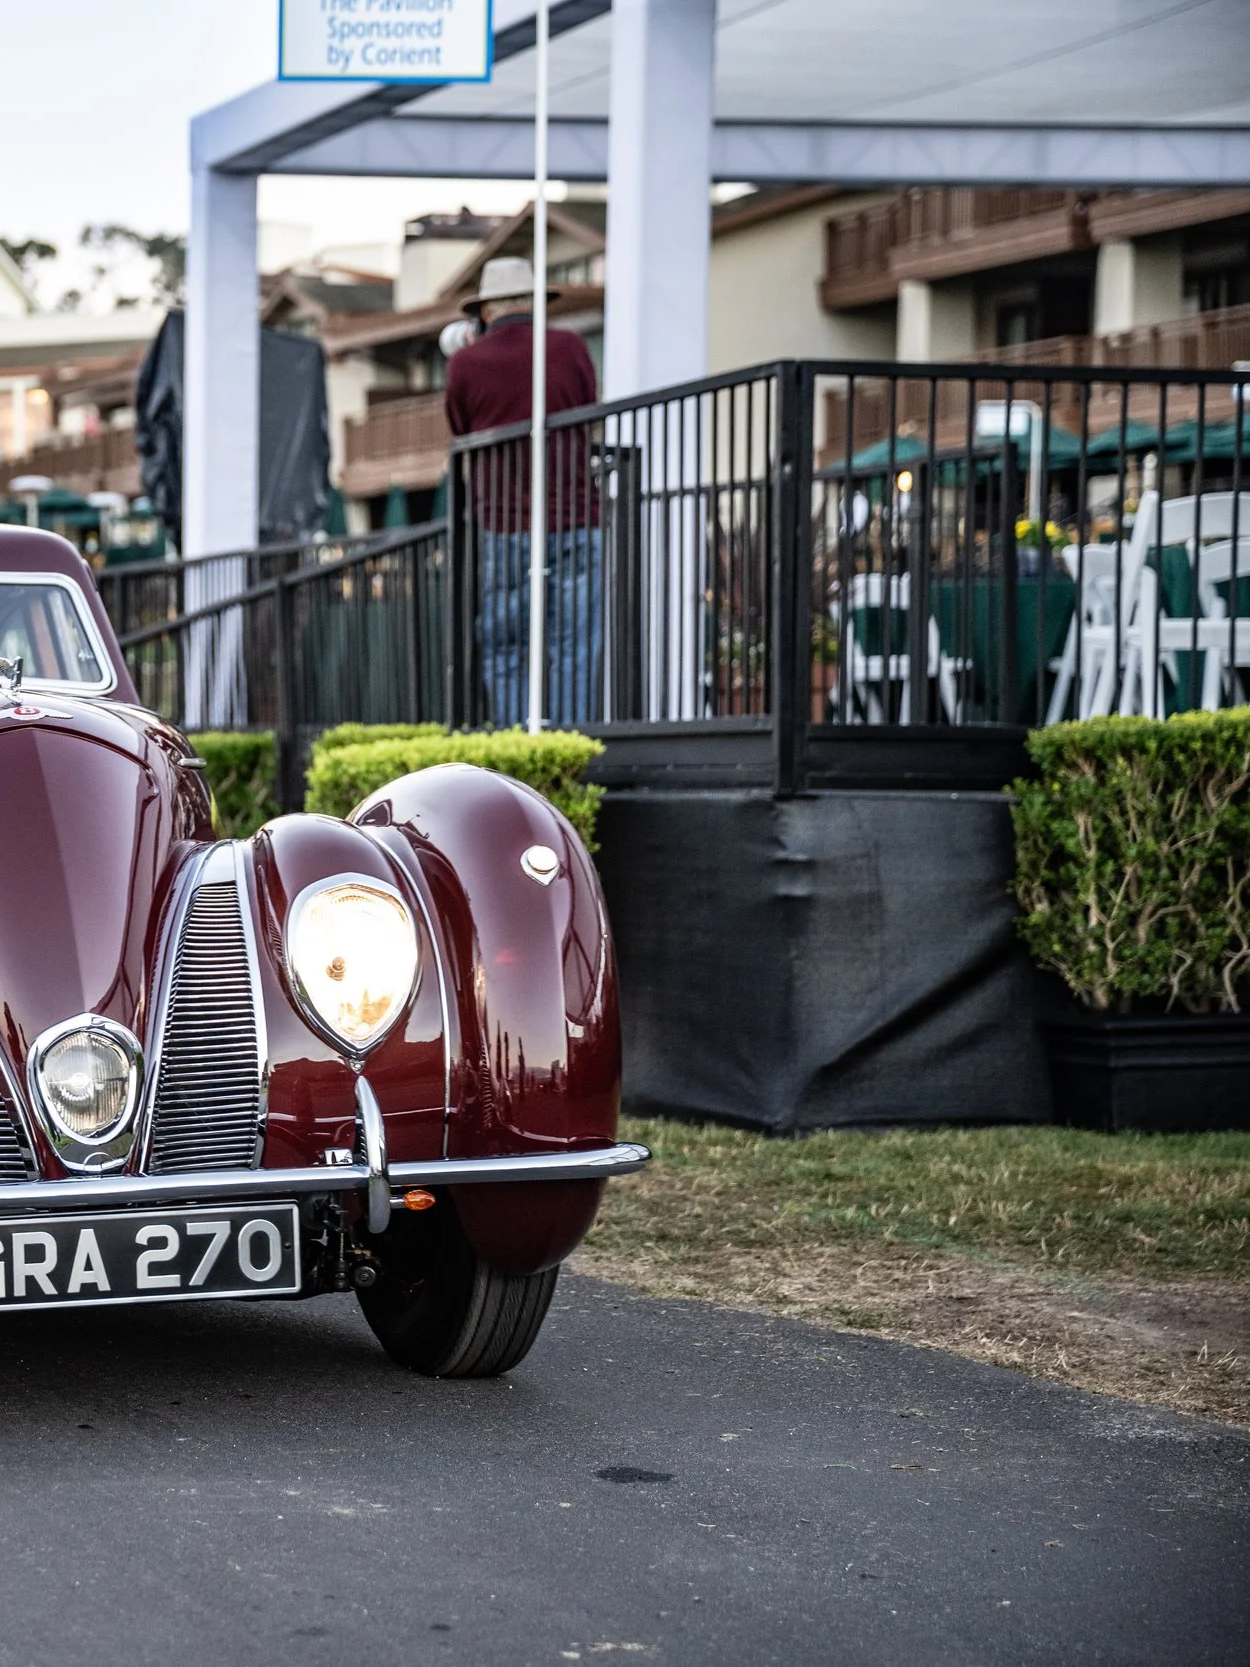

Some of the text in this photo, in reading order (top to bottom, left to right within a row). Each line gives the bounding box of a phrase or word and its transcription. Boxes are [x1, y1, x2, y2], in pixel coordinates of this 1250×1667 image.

[319, 0, 454, 12] The Pavilion
[327, 16, 443, 43] Sponsored
[327, 43, 442, 72] by Corient
[134, 1218, 283, 1290] 270
